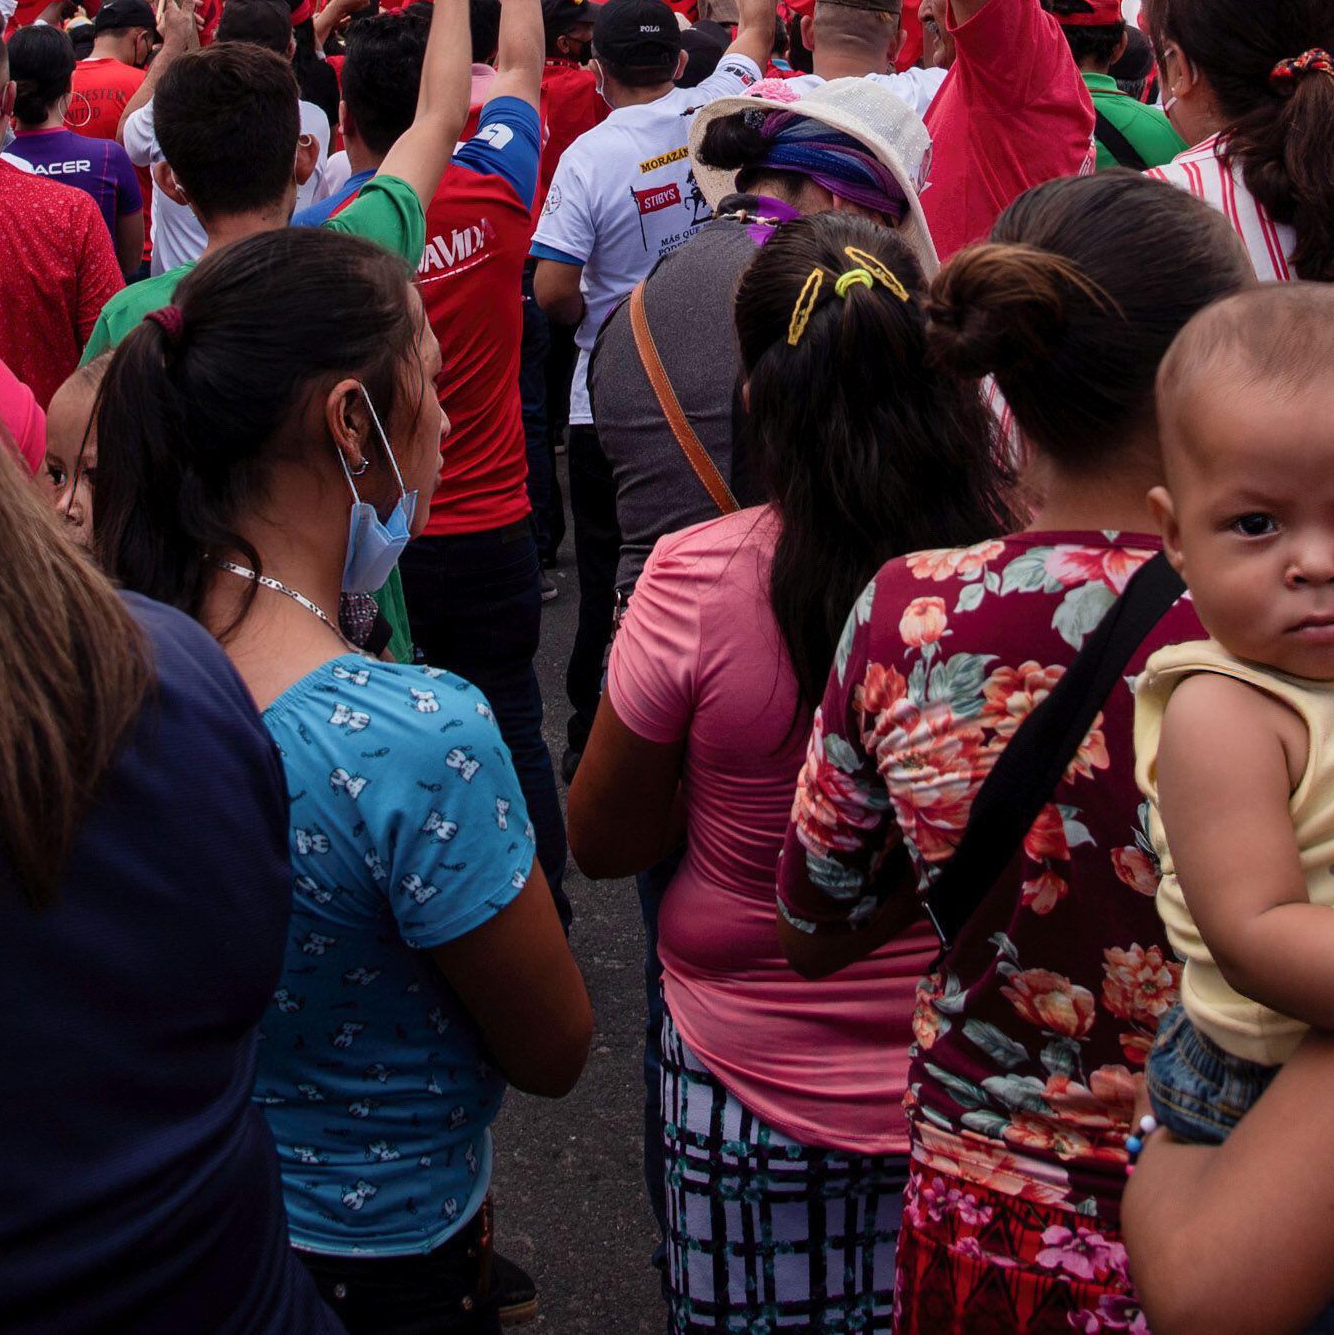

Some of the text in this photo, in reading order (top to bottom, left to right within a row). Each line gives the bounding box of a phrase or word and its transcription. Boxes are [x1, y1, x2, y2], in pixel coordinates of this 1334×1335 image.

[644, 188, 676, 210] STIBYS
[661, 225, 701, 247] MÁS QUE
